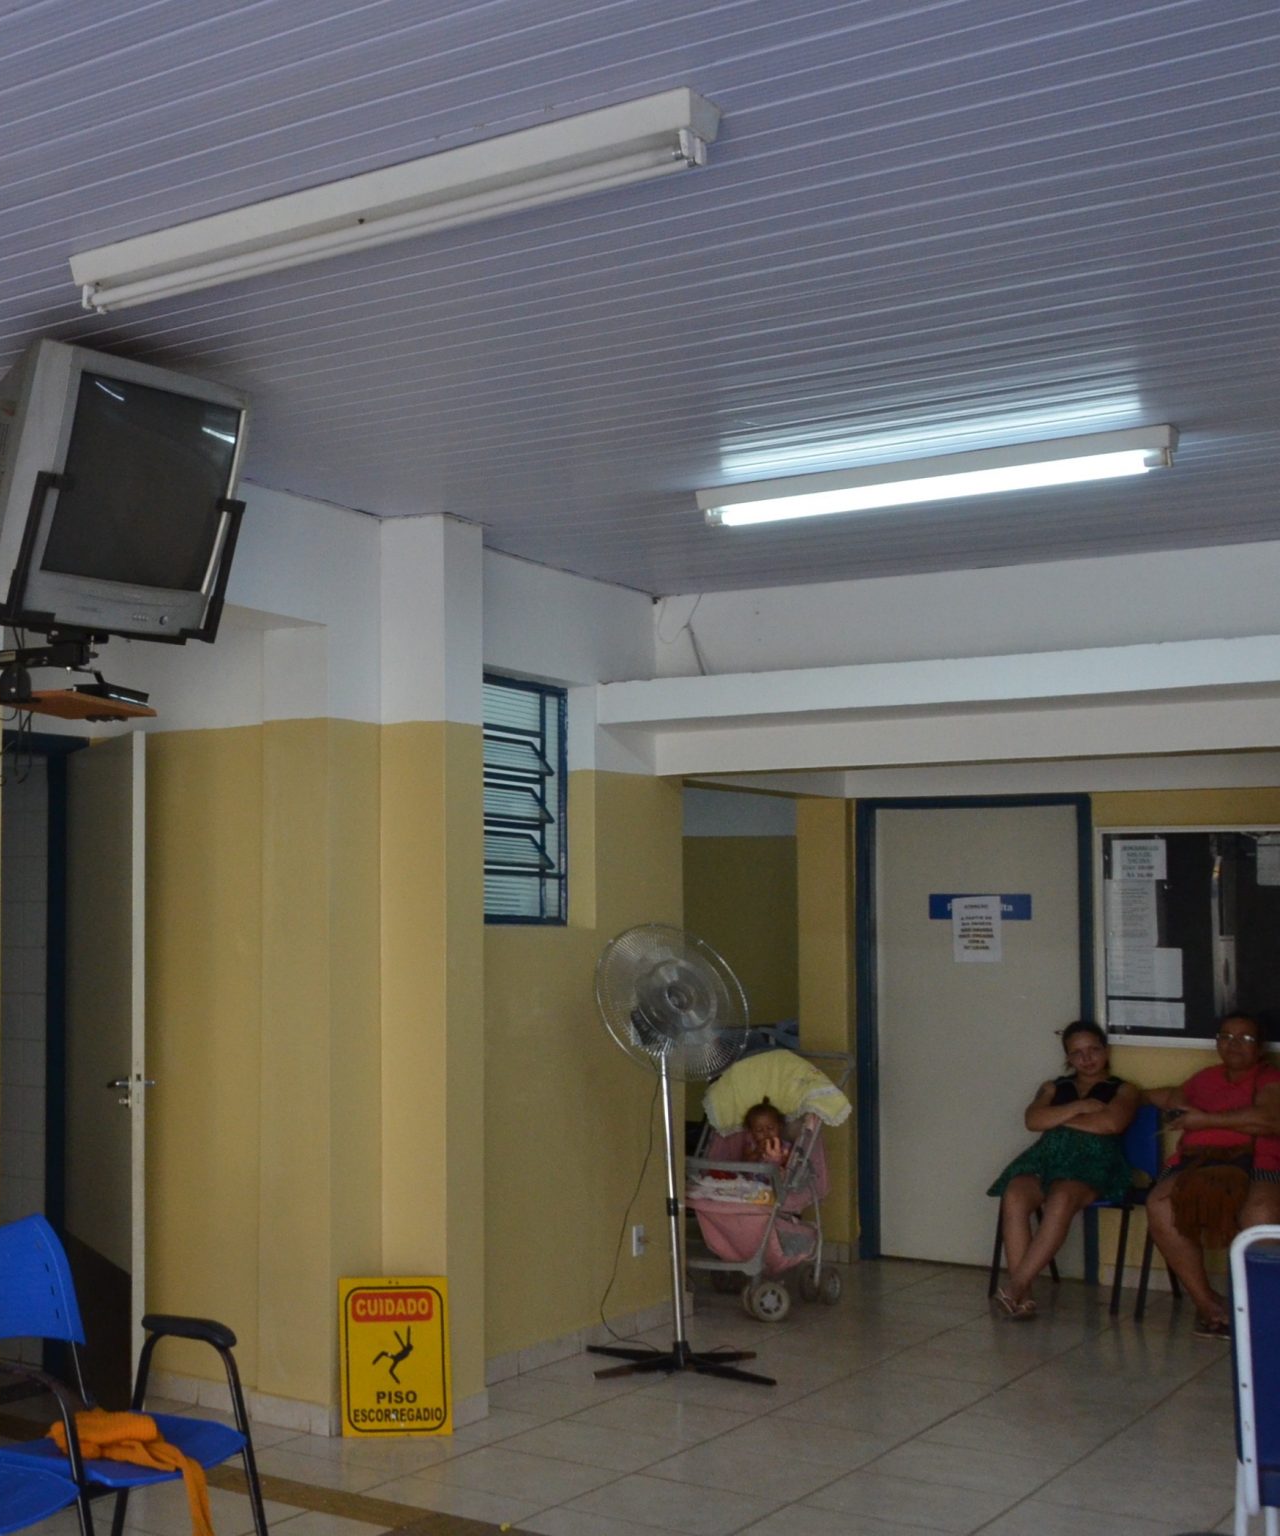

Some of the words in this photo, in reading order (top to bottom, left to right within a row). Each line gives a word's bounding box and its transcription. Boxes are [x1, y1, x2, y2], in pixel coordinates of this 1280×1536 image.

[356, 1298, 429, 1316] CUIDADO
[376, 1391, 417, 1404] PISO
[353, 1407, 443, 1423] ESCORREGADIO
